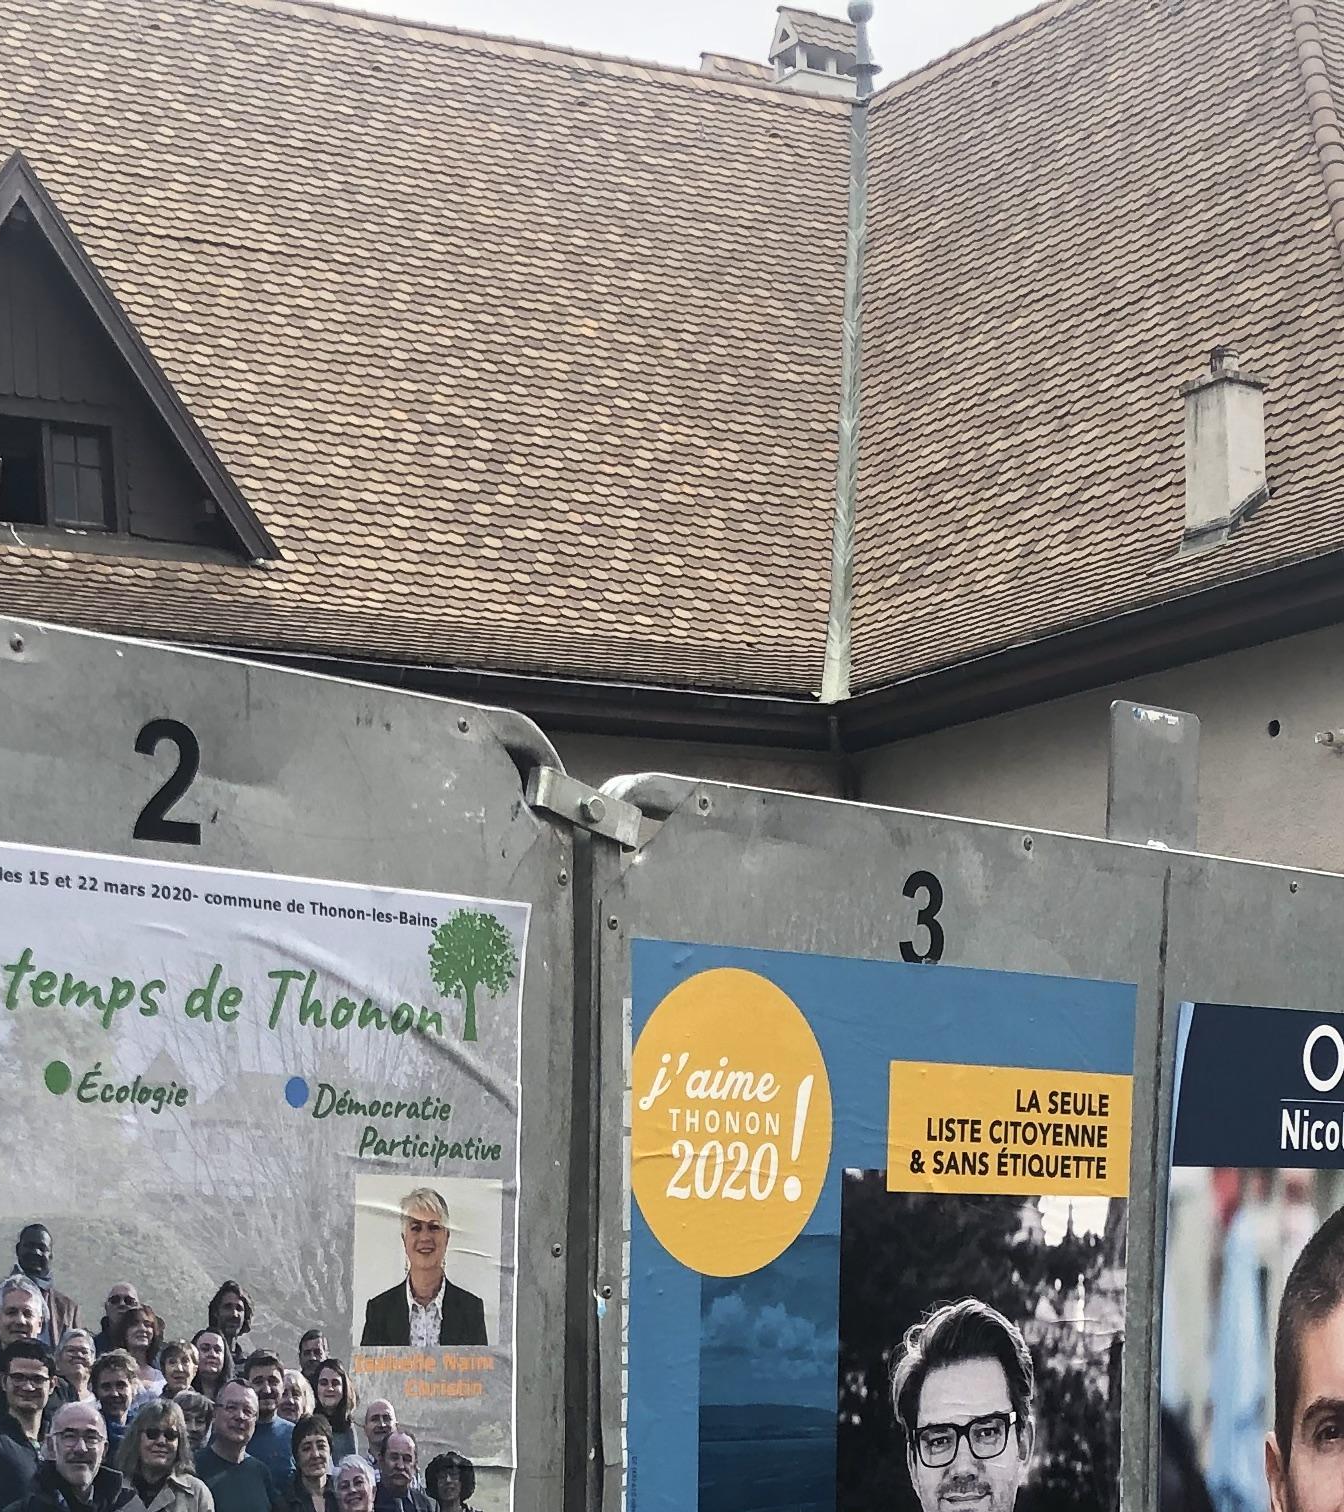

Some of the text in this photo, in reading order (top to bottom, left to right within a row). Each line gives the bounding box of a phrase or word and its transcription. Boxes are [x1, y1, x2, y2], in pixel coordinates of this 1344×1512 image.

[132, 718, 202, 846] 2
[29, 870, 49, 886] 15
[104, 881, 145, 897] mars
[205, 892, 282, 912] commune
[310, 902, 438, 928] Thonon-les-Bains
[899, 870, 945, 965] 3
[185, 964, 243, 1022] de
[267, 969, 444, 1036] Thonon
[77, 1062, 189, 1115] Écologie
[312, 1083, 452, 1121] Démocratie
[1016, 1089, 1110, 1117] LA SEULE
[359, 1126, 502, 1168] Participative
[669, 1107, 781, 1137] THONON
[926, 1117, 1109, 1148] LISTE CITOYENNE
[932, 1147, 1107, 1180] SANS ÉTIQUETTE
